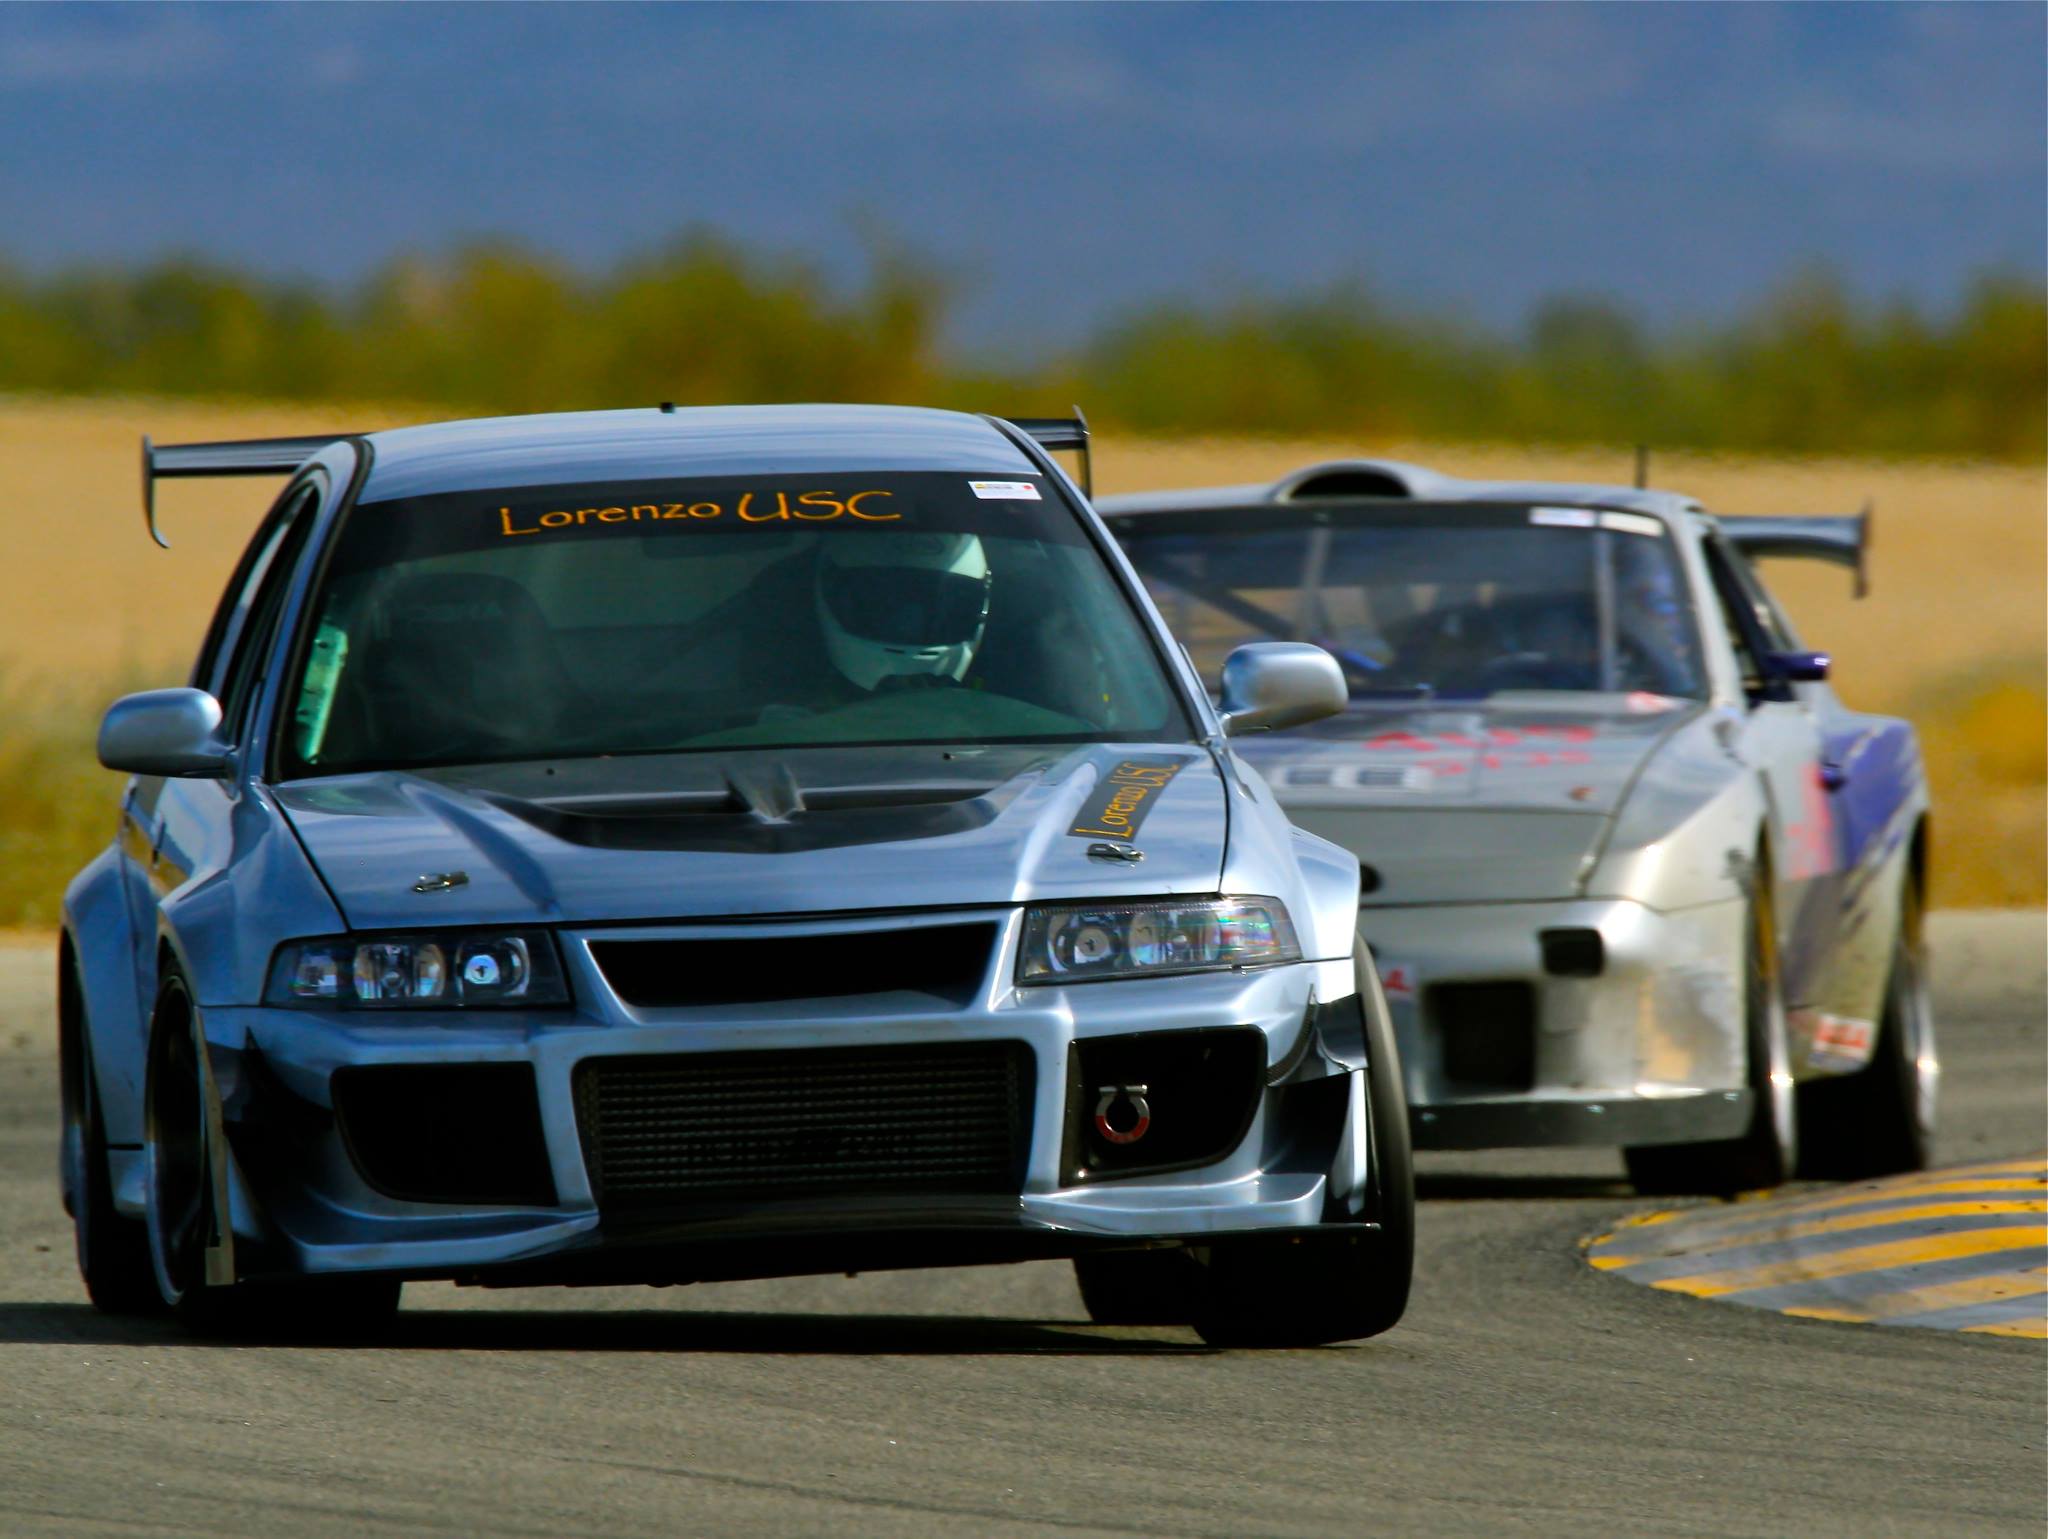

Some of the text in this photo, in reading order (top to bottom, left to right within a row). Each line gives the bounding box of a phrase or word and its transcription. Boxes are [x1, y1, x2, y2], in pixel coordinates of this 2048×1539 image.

[500, 490, 902, 536] Lorenzo USC
[1075, 786, 1149, 838] Lorenzo
